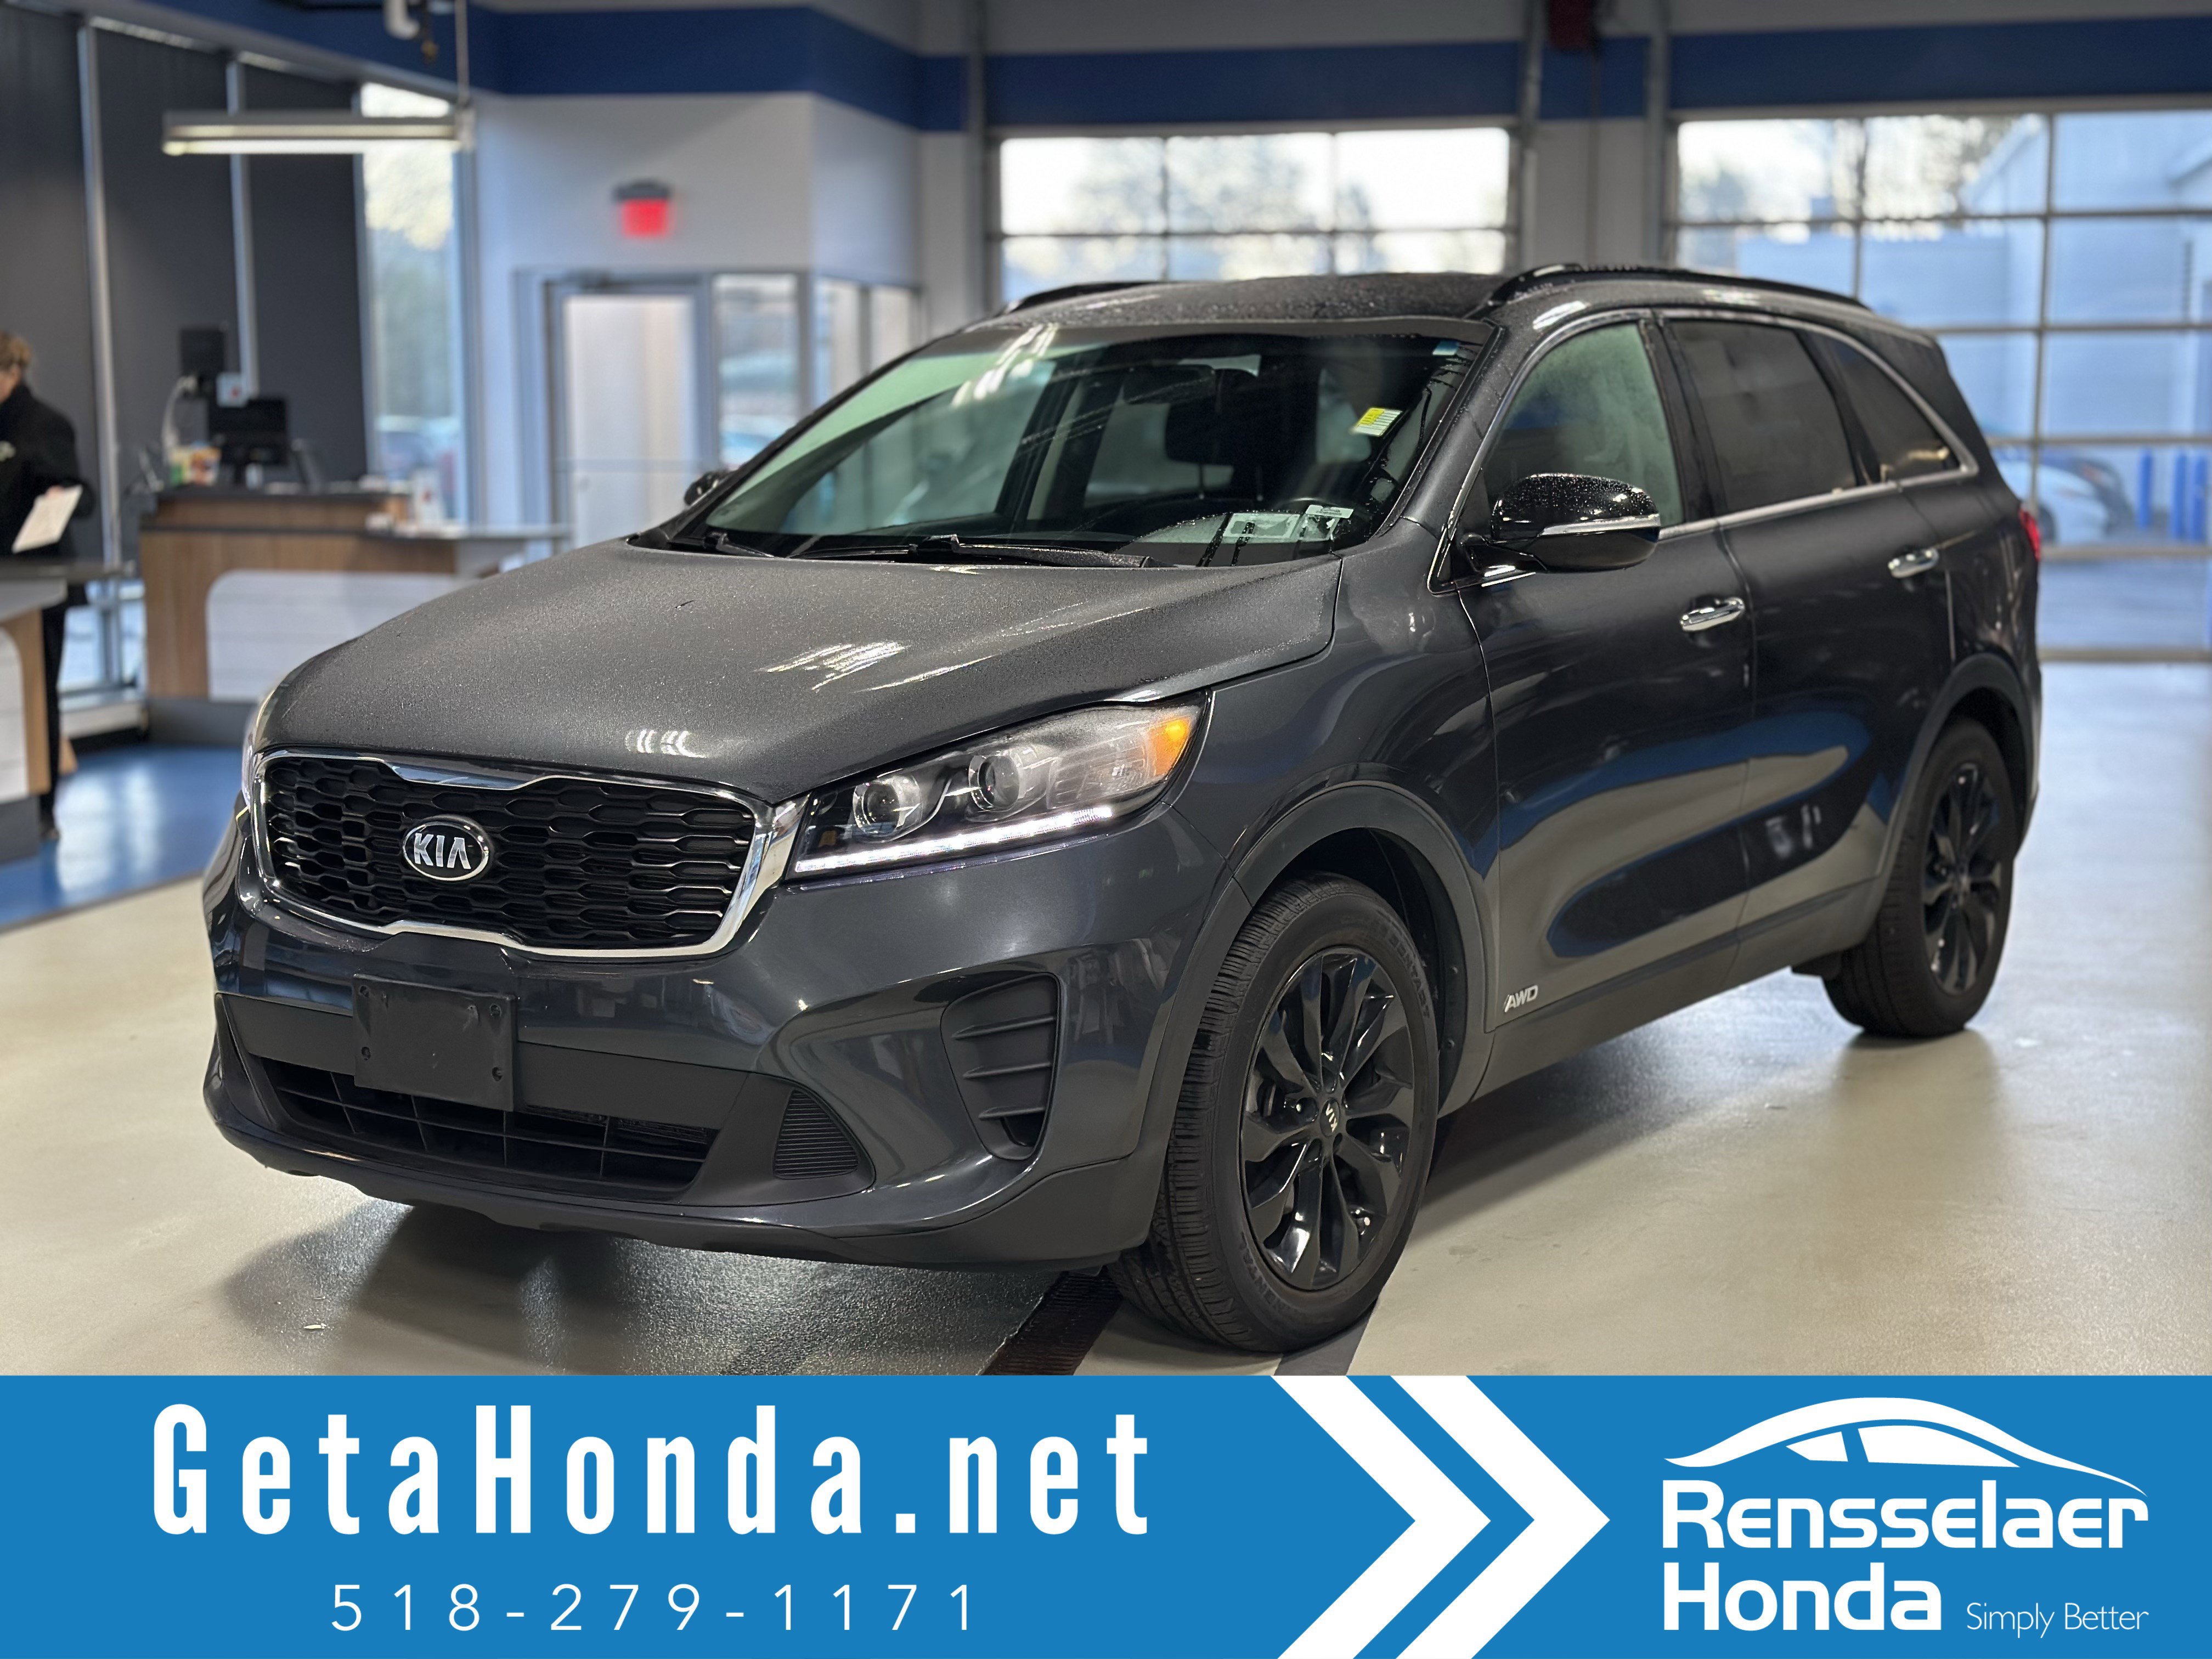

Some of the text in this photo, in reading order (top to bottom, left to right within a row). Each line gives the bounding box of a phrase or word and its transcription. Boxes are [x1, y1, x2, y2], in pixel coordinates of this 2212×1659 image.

[414, 833, 471, 870] KIA
[1503, 984, 1538, 1013] AWD
[1325, 1102, 1338, 1133] KIA
